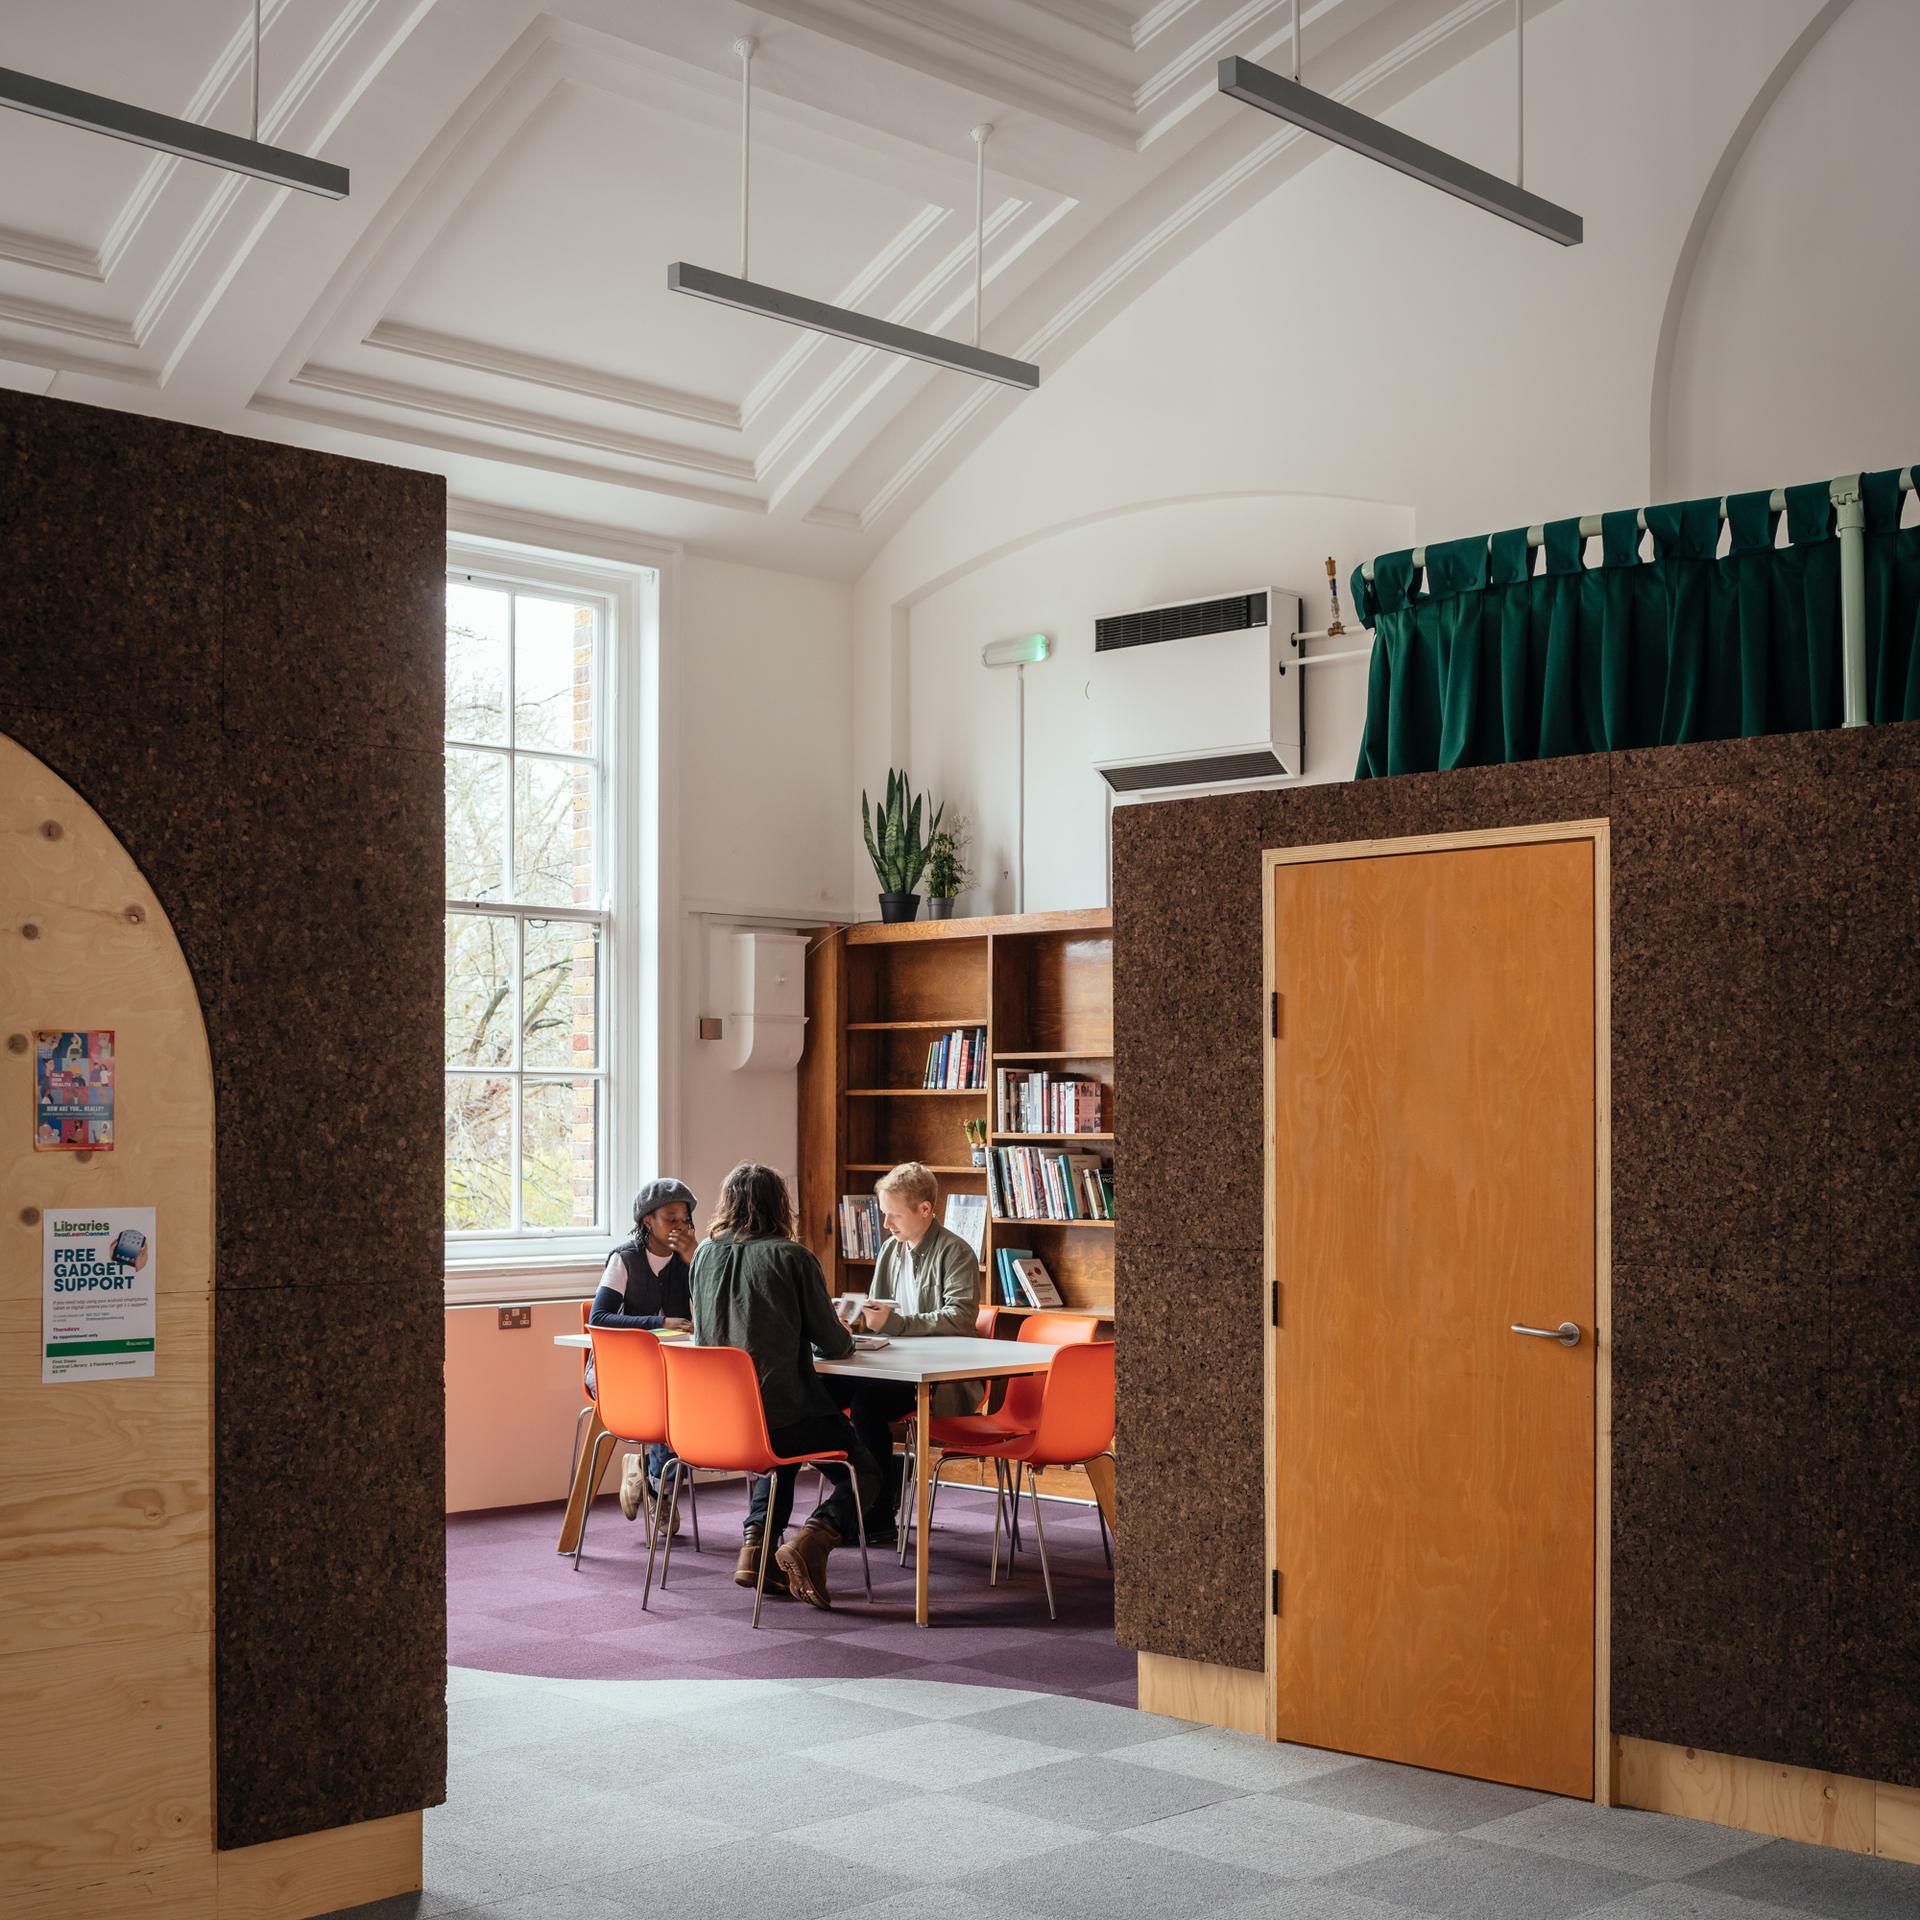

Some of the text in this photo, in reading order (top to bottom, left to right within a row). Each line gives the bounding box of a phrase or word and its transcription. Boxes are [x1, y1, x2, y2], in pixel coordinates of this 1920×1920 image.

[54, 1220, 110, 1232] Libraries
[54, 1248, 96, 1262] FREE
[54, 1262, 124, 1278] GADGET
[54, 1276, 135, 1292] SUPPORT
